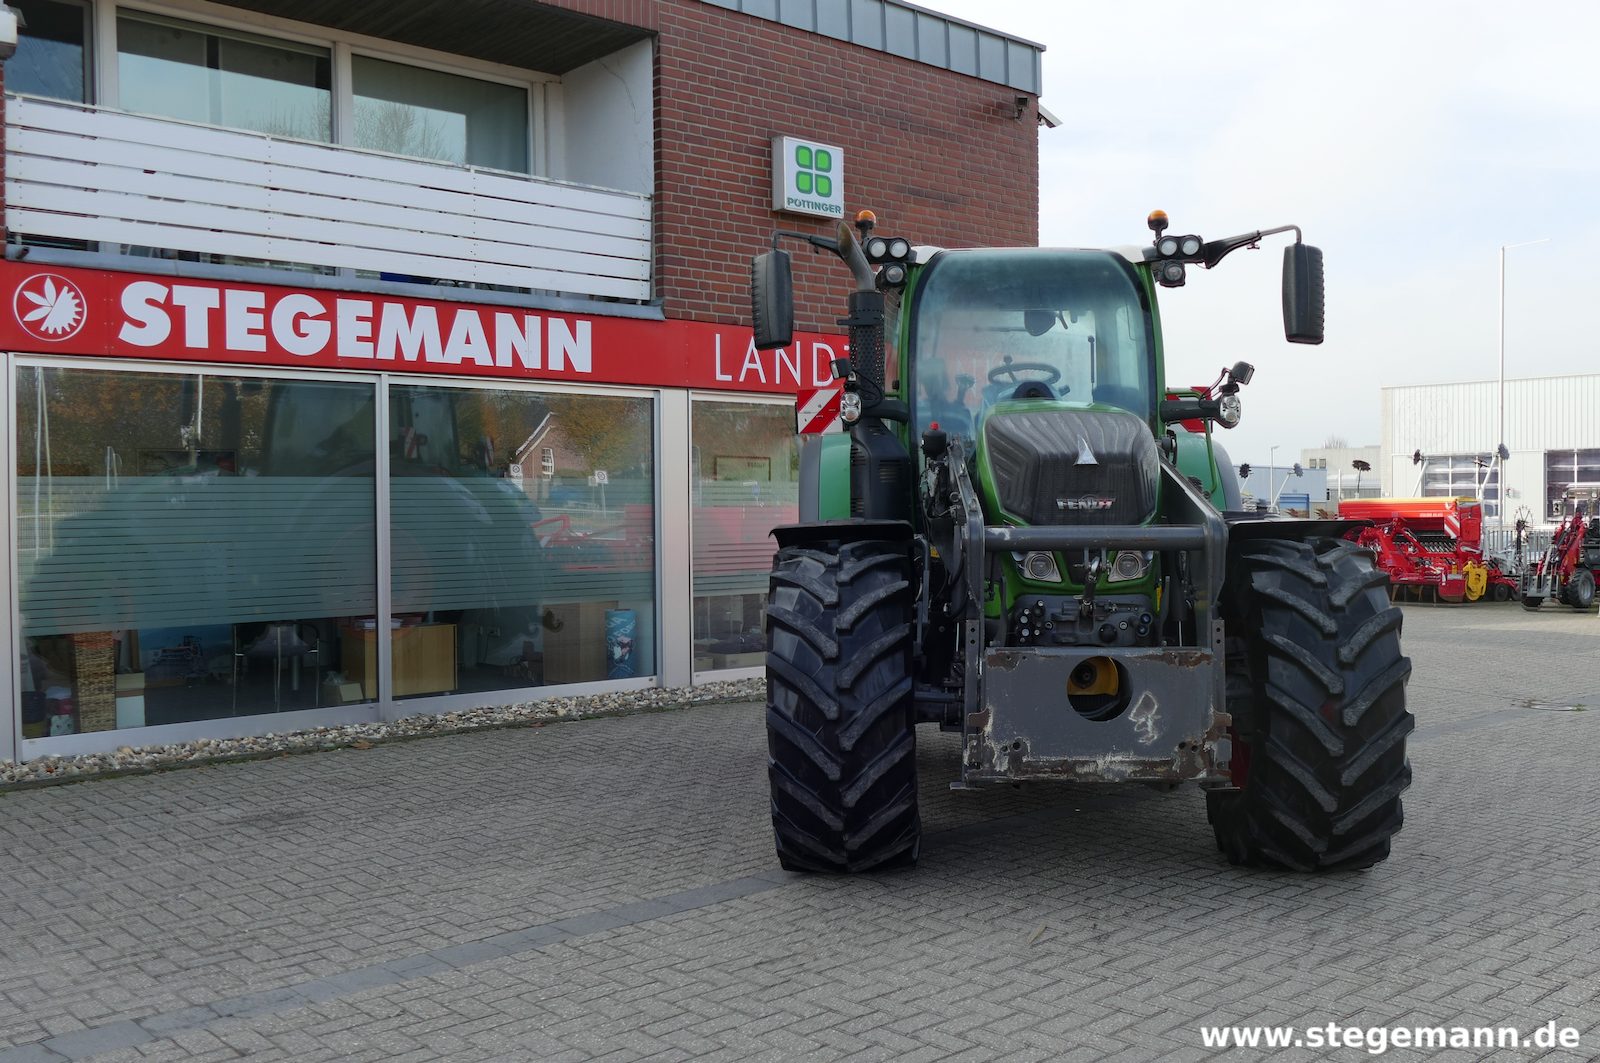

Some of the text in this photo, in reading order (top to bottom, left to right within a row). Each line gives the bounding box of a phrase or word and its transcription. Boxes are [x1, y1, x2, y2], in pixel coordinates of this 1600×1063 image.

[118, 281, 592, 373] STEGEMANN
[715, 333, 850, 387] LAND
[1056, 498, 1116, 510] FENDT
